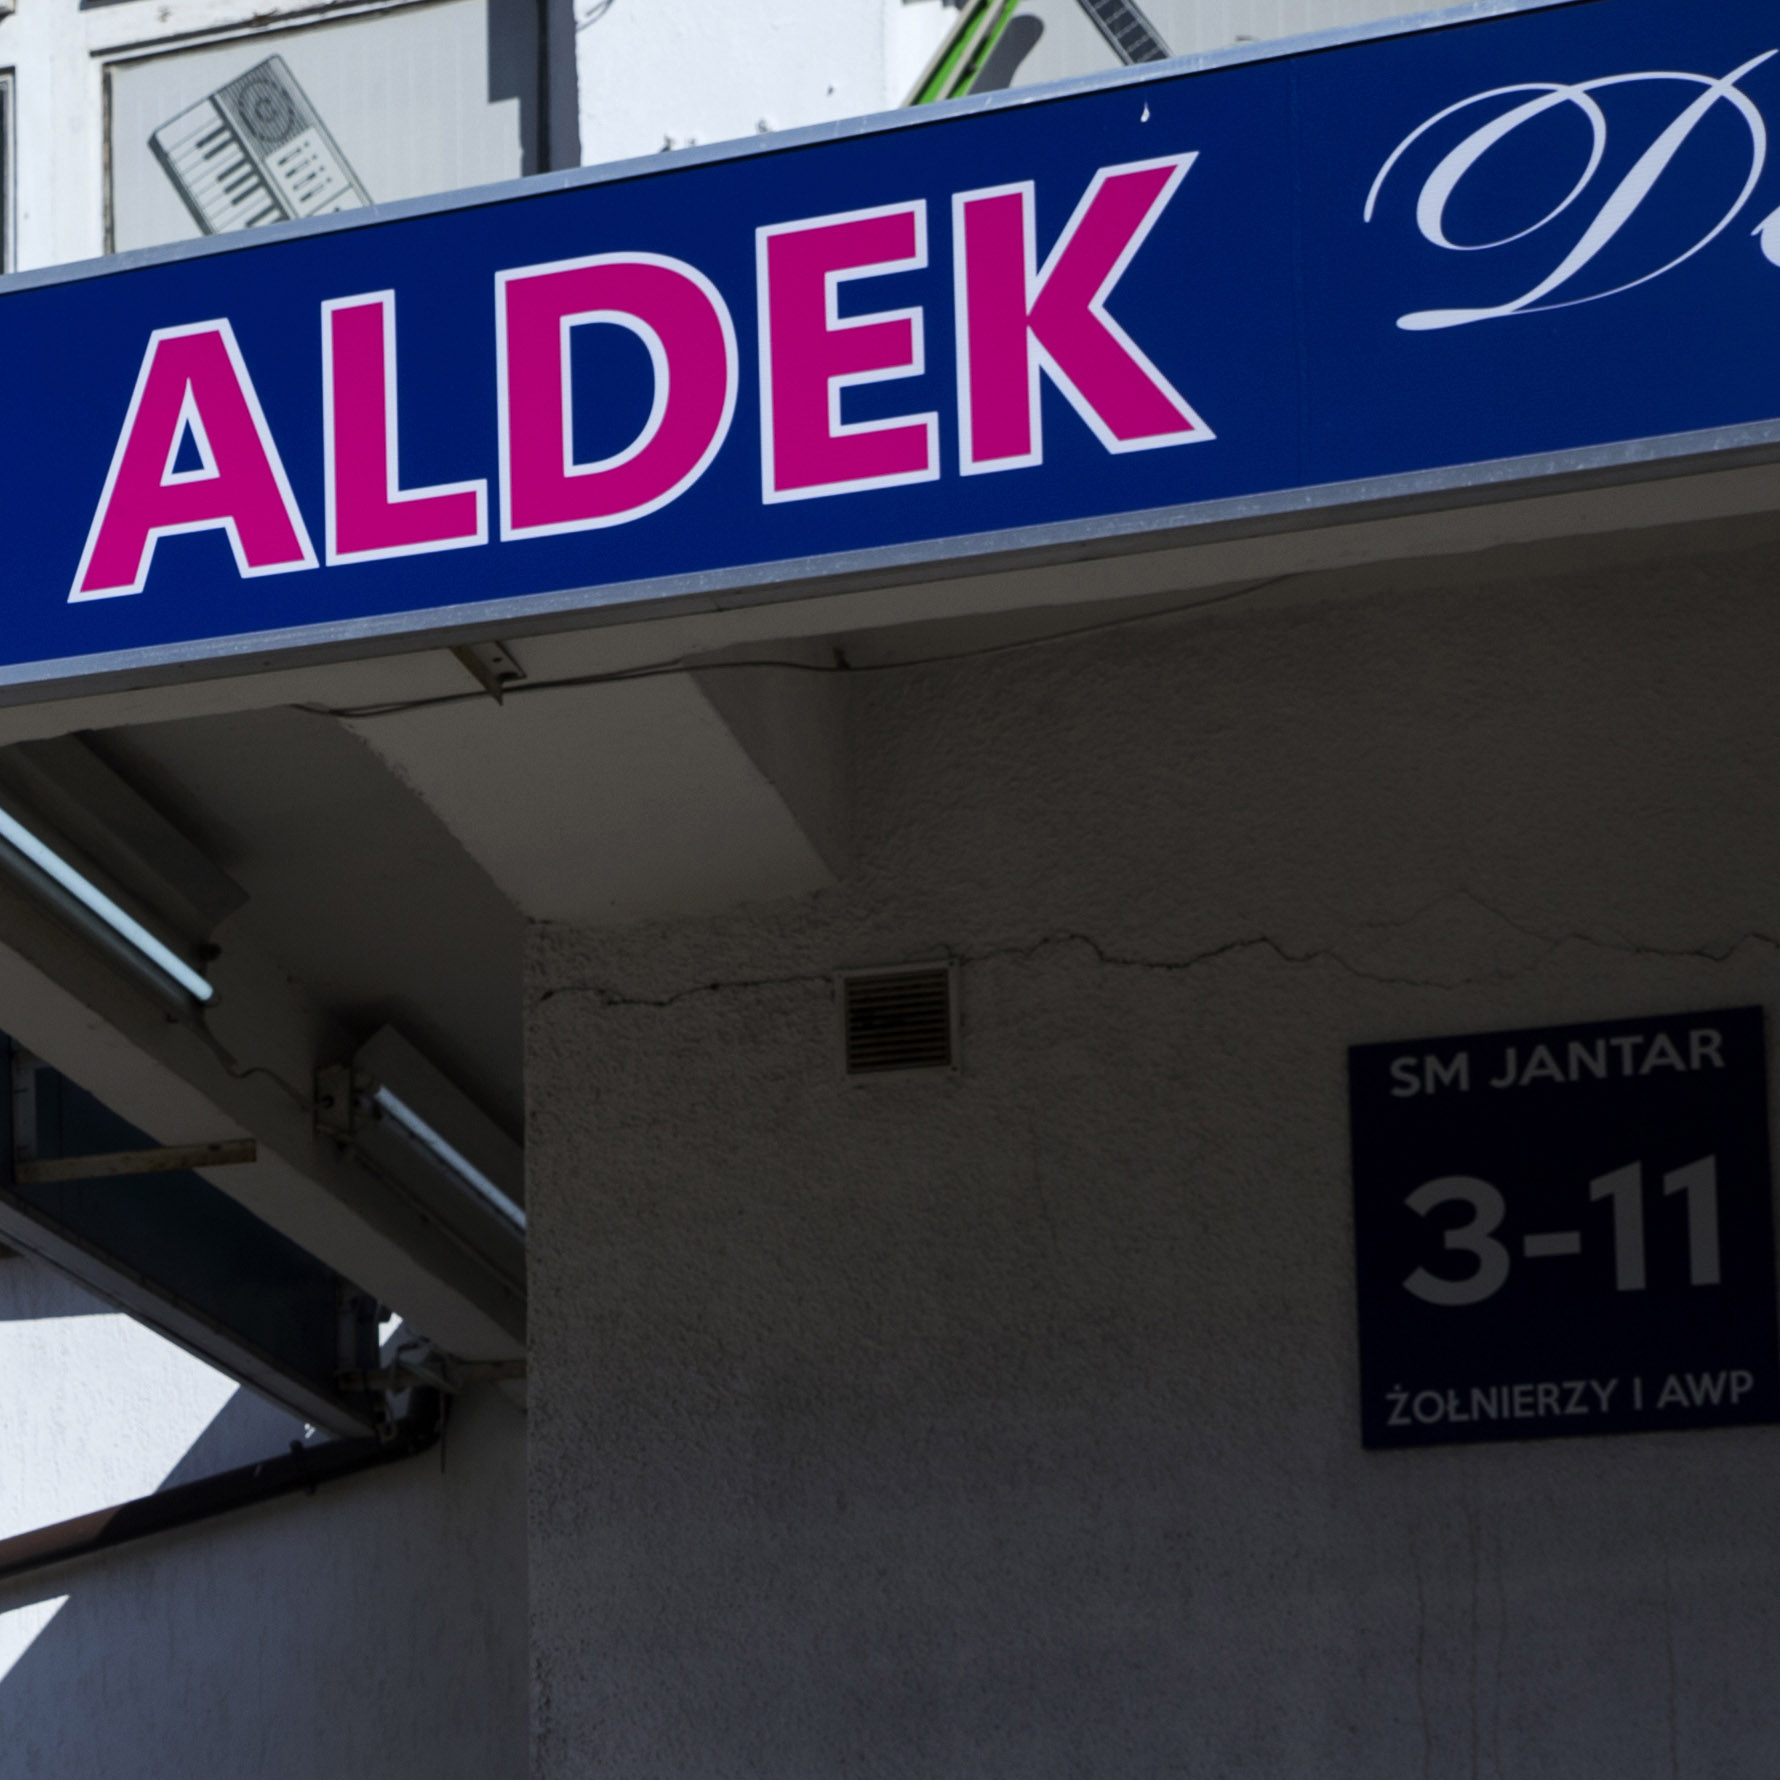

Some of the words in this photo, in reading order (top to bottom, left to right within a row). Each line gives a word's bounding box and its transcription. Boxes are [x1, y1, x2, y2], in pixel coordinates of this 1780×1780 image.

[66, 149, 1218, 604] ALDEK
[1364, 48, 1780, 331] D
[1390, 1051, 1470, 1098] SM
[1489, 1028, 1726, 1089] JANTAR
[1402, 1154, 1721, 1306] 3-11
[1385, 1376, 1619, 1426] ŻOŁNIERZY
[1633, 1377, 1644, 1411] I
[1656, 1370, 1755, 1408] AWP
